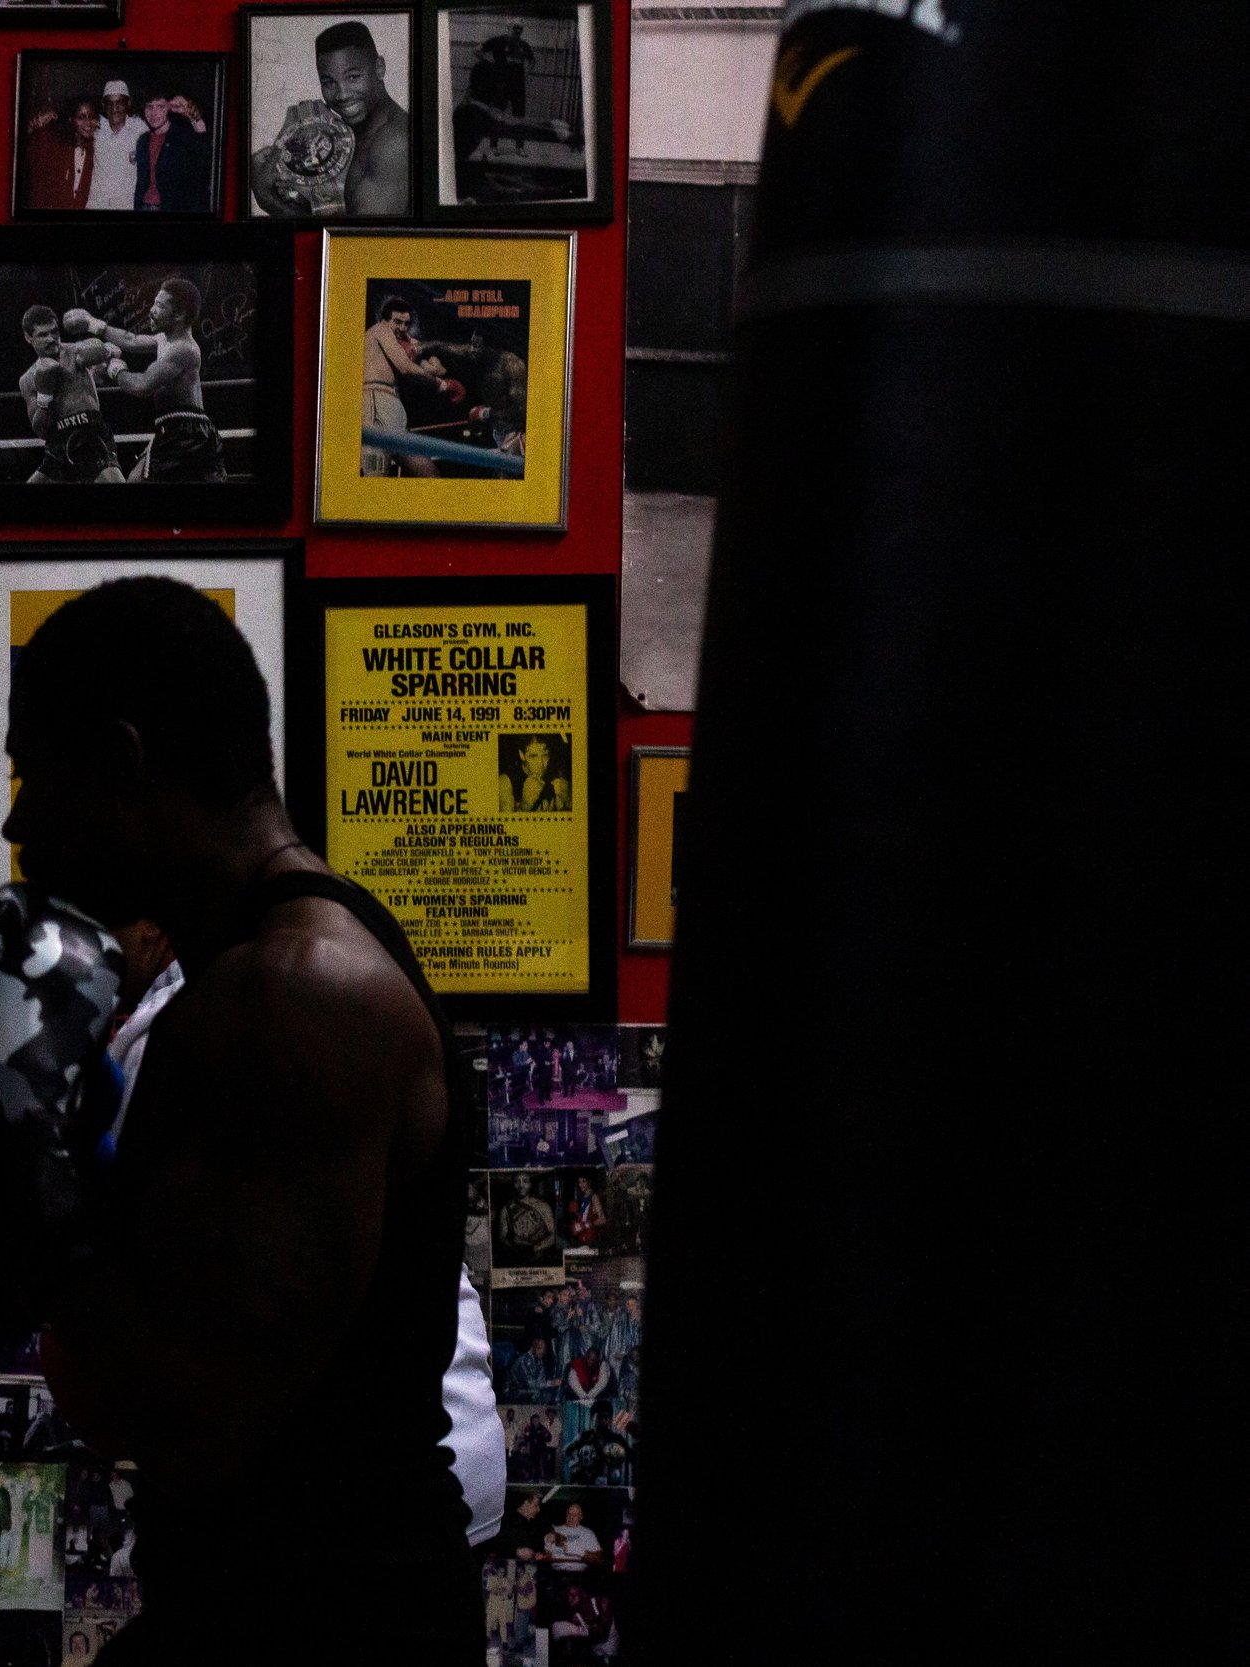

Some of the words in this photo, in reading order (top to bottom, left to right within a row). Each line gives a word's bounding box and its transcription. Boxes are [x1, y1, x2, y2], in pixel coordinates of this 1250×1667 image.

[374, 624, 458, 638] GLEASON'S
[463, 623, 501, 639] GYM,
[362, 648, 441, 671] WHITE
[449, 647, 545, 670] COLLAR
[391, 672, 517, 697] SPARRING
[341, 708, 390, 722] FRIDAY
[402, 707, 442, 721] JUNE
[470, 707, 500, 721] 1991
[514, 706, 570, 720] 8:30PM
[422, 732, 452, 742] MAIN
[456, 731, 490, 741] EVENT
[398, 750, 423, 758] Collar
[425, 750, 466, 759] Champion
[372, 761, 438, 787] DAVID
[342, 789, 468, 815] LAWRENCE
[406, 824, 436, 835] ALSO
[394, 836, 456, 847] GLEASON'S
[460, 836, 519, 847] REGULARS
[381, 849, 407, 857] HARVEY
[502, 867, 526, 875] VICTOR
[387, 895, 407, 905] 1ST
[412, 895, 466, 905] WOMEN'S
[470, 894, 527, 905] SPARRING
[426, 907, 488, 918] FEATURING
[483, 918, 514, 927] HAWKINS
[404, 929, 427, 937] ARKLE
[462, 929, 493, 937] BARBARA
[416, 946, 473, 957] SPARRING
[477, 946, 512, 957] RULES
[516, 946, 552, 957] APPLY
[450, 959, 479, 969] Minute
